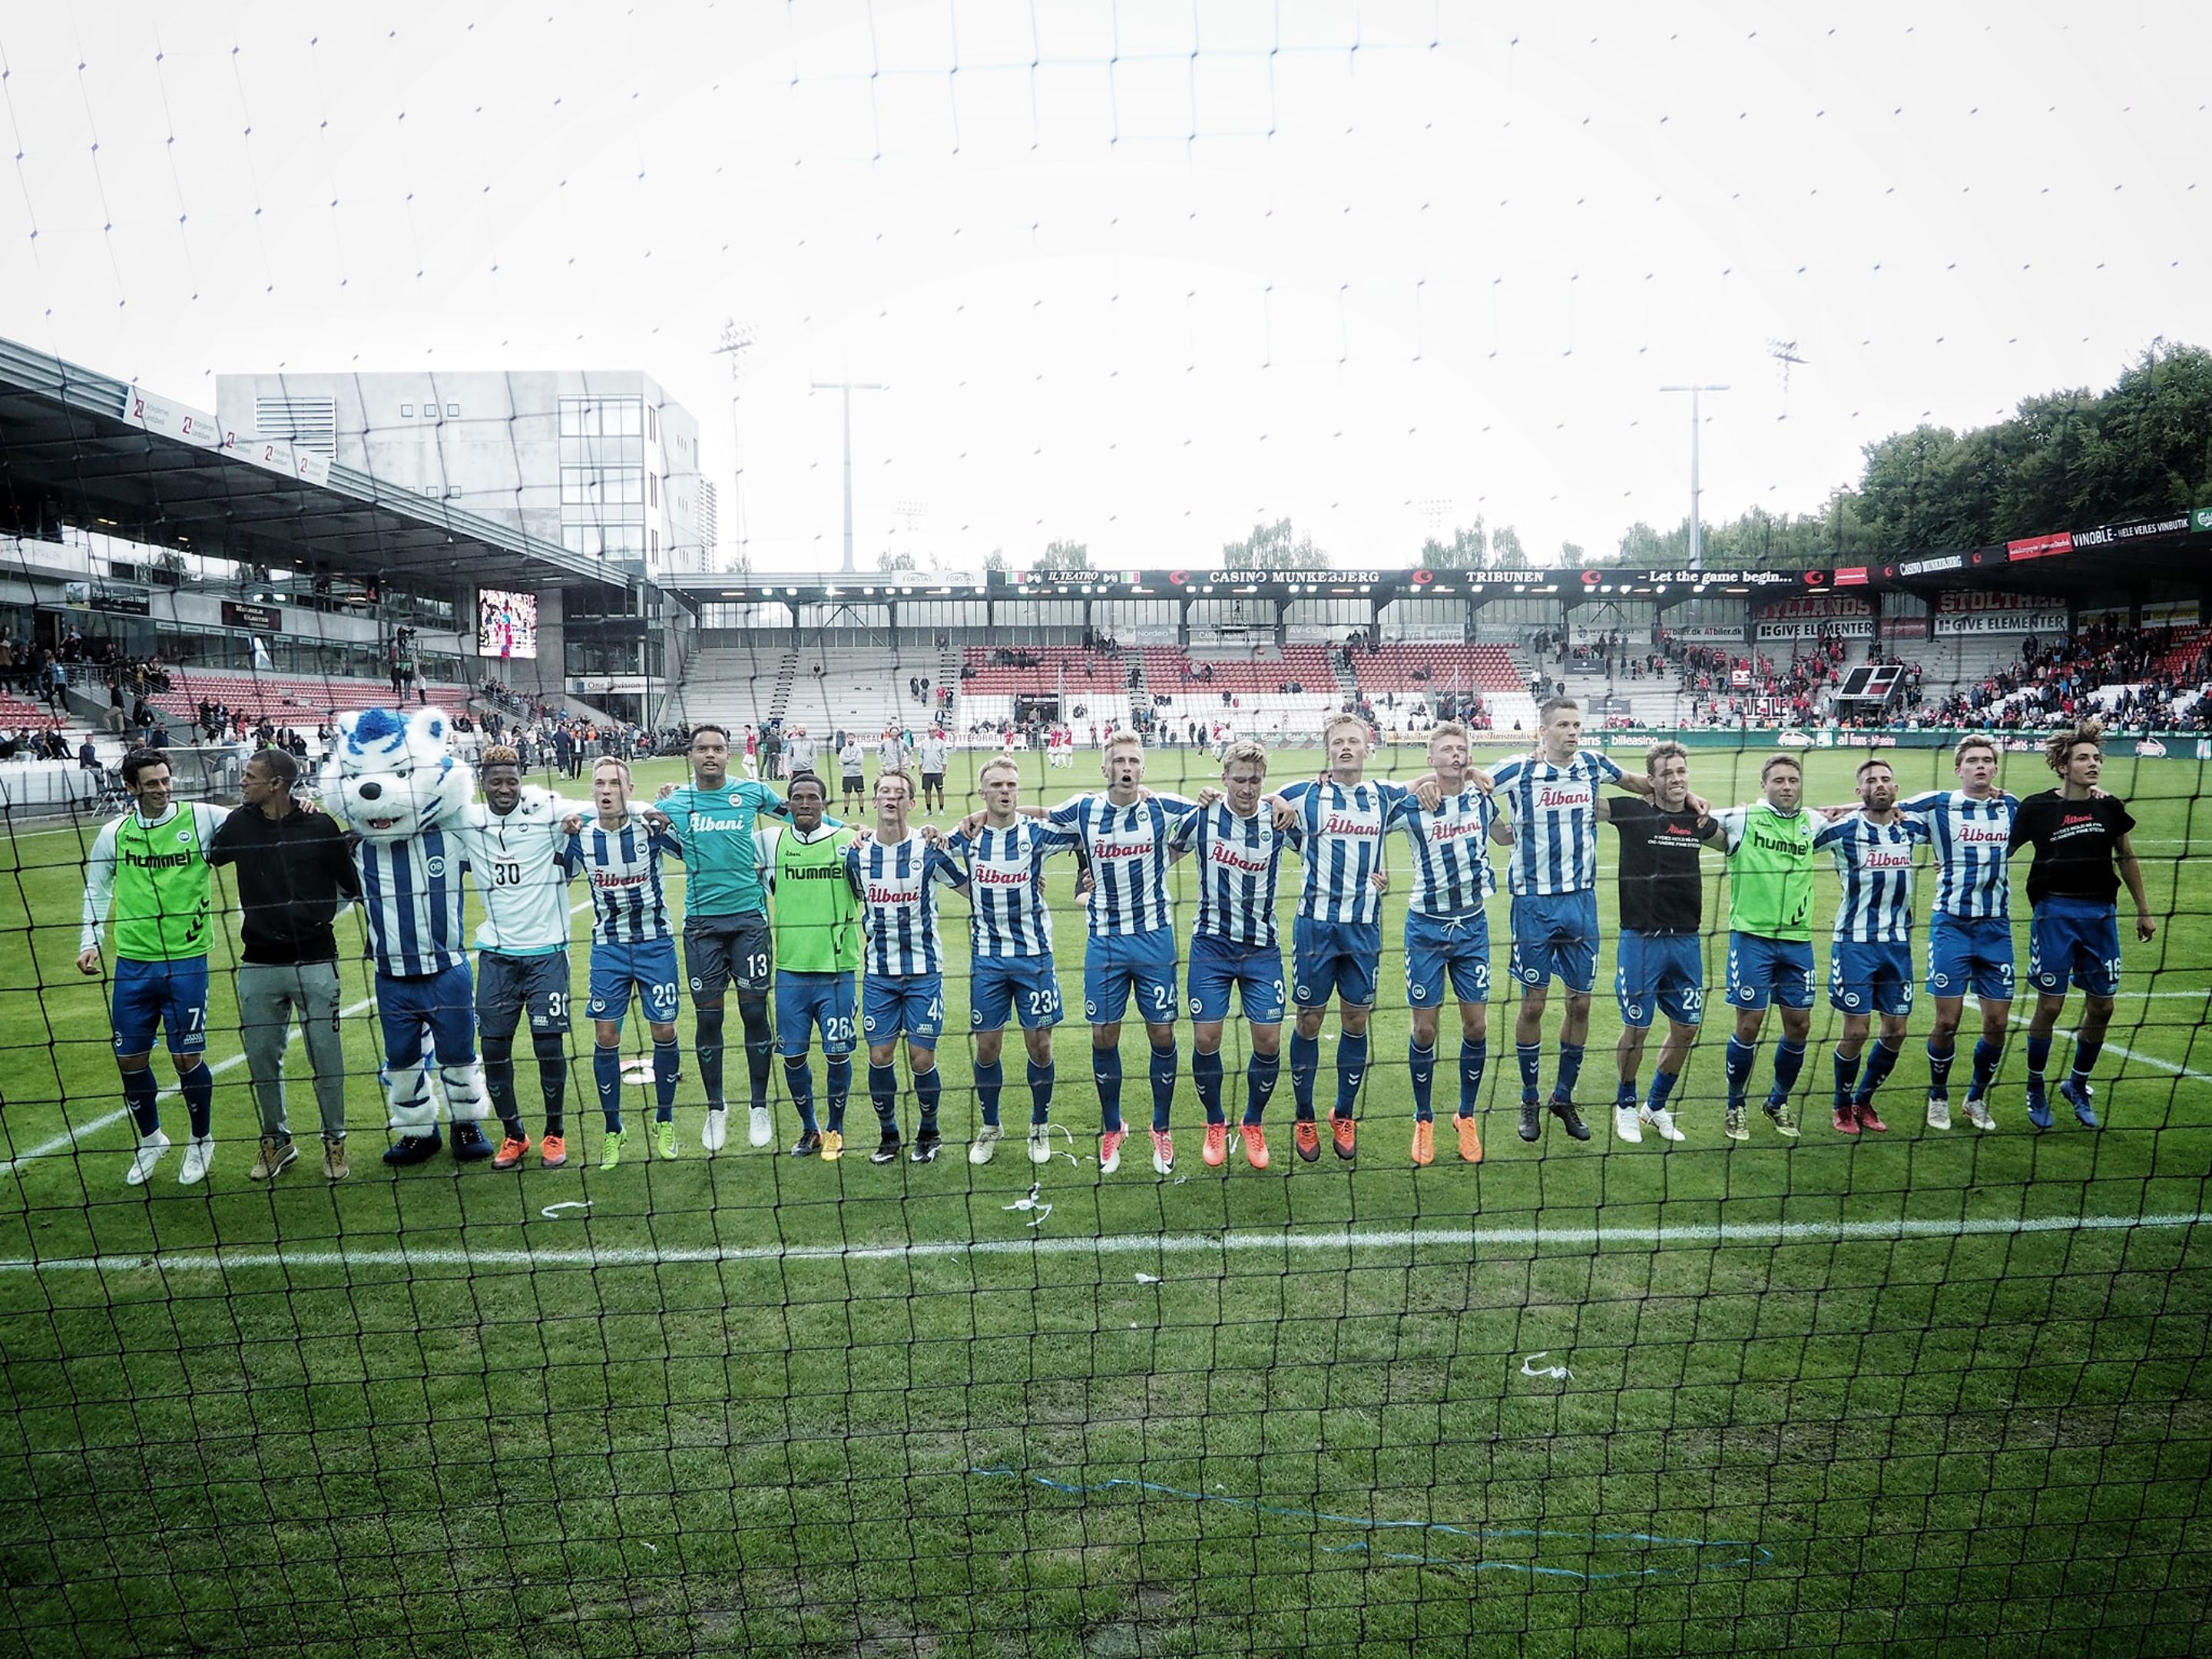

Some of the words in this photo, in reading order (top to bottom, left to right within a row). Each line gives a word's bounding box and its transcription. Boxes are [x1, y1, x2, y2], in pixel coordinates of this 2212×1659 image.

[2072, 528, 2114, 547] VINOBLE
[2157, 518, 2189, 532] VINBUTIK
[1060, 571, 1098, 581] TEATRO
[1210, 571, 1267, 584] CASINO
[1272, 571, 1380, 584] MUNKEBJERG
[1466, 571, 1545, 583] TRIBUNEN
[1650, 571, 1675, 582] Let
[1676, 571, 1699, 582] the
[1701, 574, 1738, 584] game
[1773, 624, 1800, 636] GIVE
[1953, 618, 1983, 631] GIVE
[1988, 616, 2065, 630] ELEMENTER
[588, 681, 605, 690] One
[1744, 697, 1788, 717] VEJLE
[945, 733, 1022, 743] FLYTTEFORRETNG
[1535, 789, 1590, 807] Albani
[685, 813, 744, 833] Albani
[1321, 817, 1379, 836] Albani
[1428, 816, 1482, 843] Albani
[1754, 831, 1809, 856] hummel
[1953, 826, 2008, 843] Albani
[1092, 838, 1154, 859] Albani
[125, 849, 191, 869] hummel
[1209, 846, 1267, 872] Albani
[1863, 851, 1910, 867] Albani
[495, 863, 520, 886] 30
[594, 869, 647, 888] Albani
[785, 863, 845, 880] hummel
[972, 866, 1030, 884] Albani
[868, 886, 919, 903] Albani
[747, 954, 768, 978] 13
[2104, 956, 2121, 983] 16
[652, 982, 677, 1008] 20
[1029, 988, 1053, 1015] 23
[1154, 983, 1177, 1010] 24
[1681, 988, 1703, 1011] 28
[188, 1007, 200, 1031] 7
[827, 1017, 849, 1041] 26
